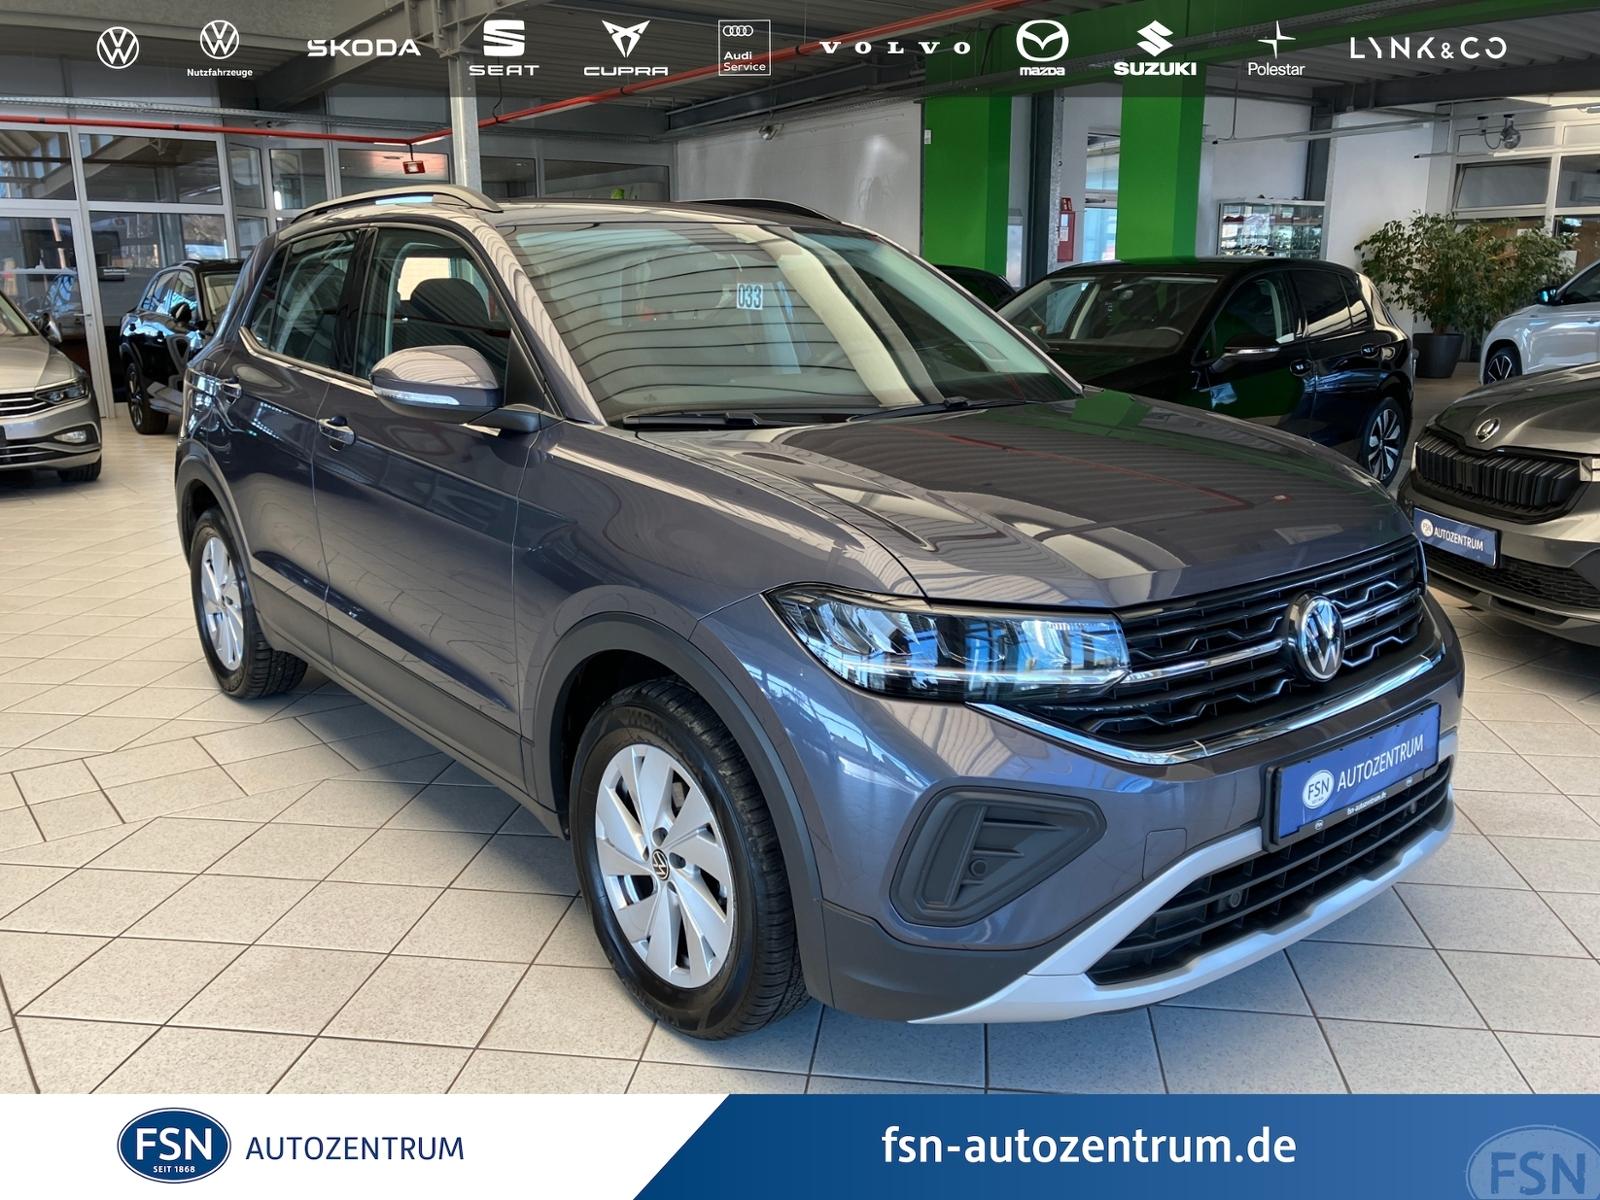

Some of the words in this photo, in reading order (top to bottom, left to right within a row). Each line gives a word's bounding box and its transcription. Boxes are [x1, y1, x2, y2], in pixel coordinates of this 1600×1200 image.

[738, 284, 762, 309] 033
[1433, 526, 1484, 552] AUTOZENTRUM
[1307, 777, 1331, 800] FSN
[1336, 733, 1424, 793] AUTOZENTRUM
